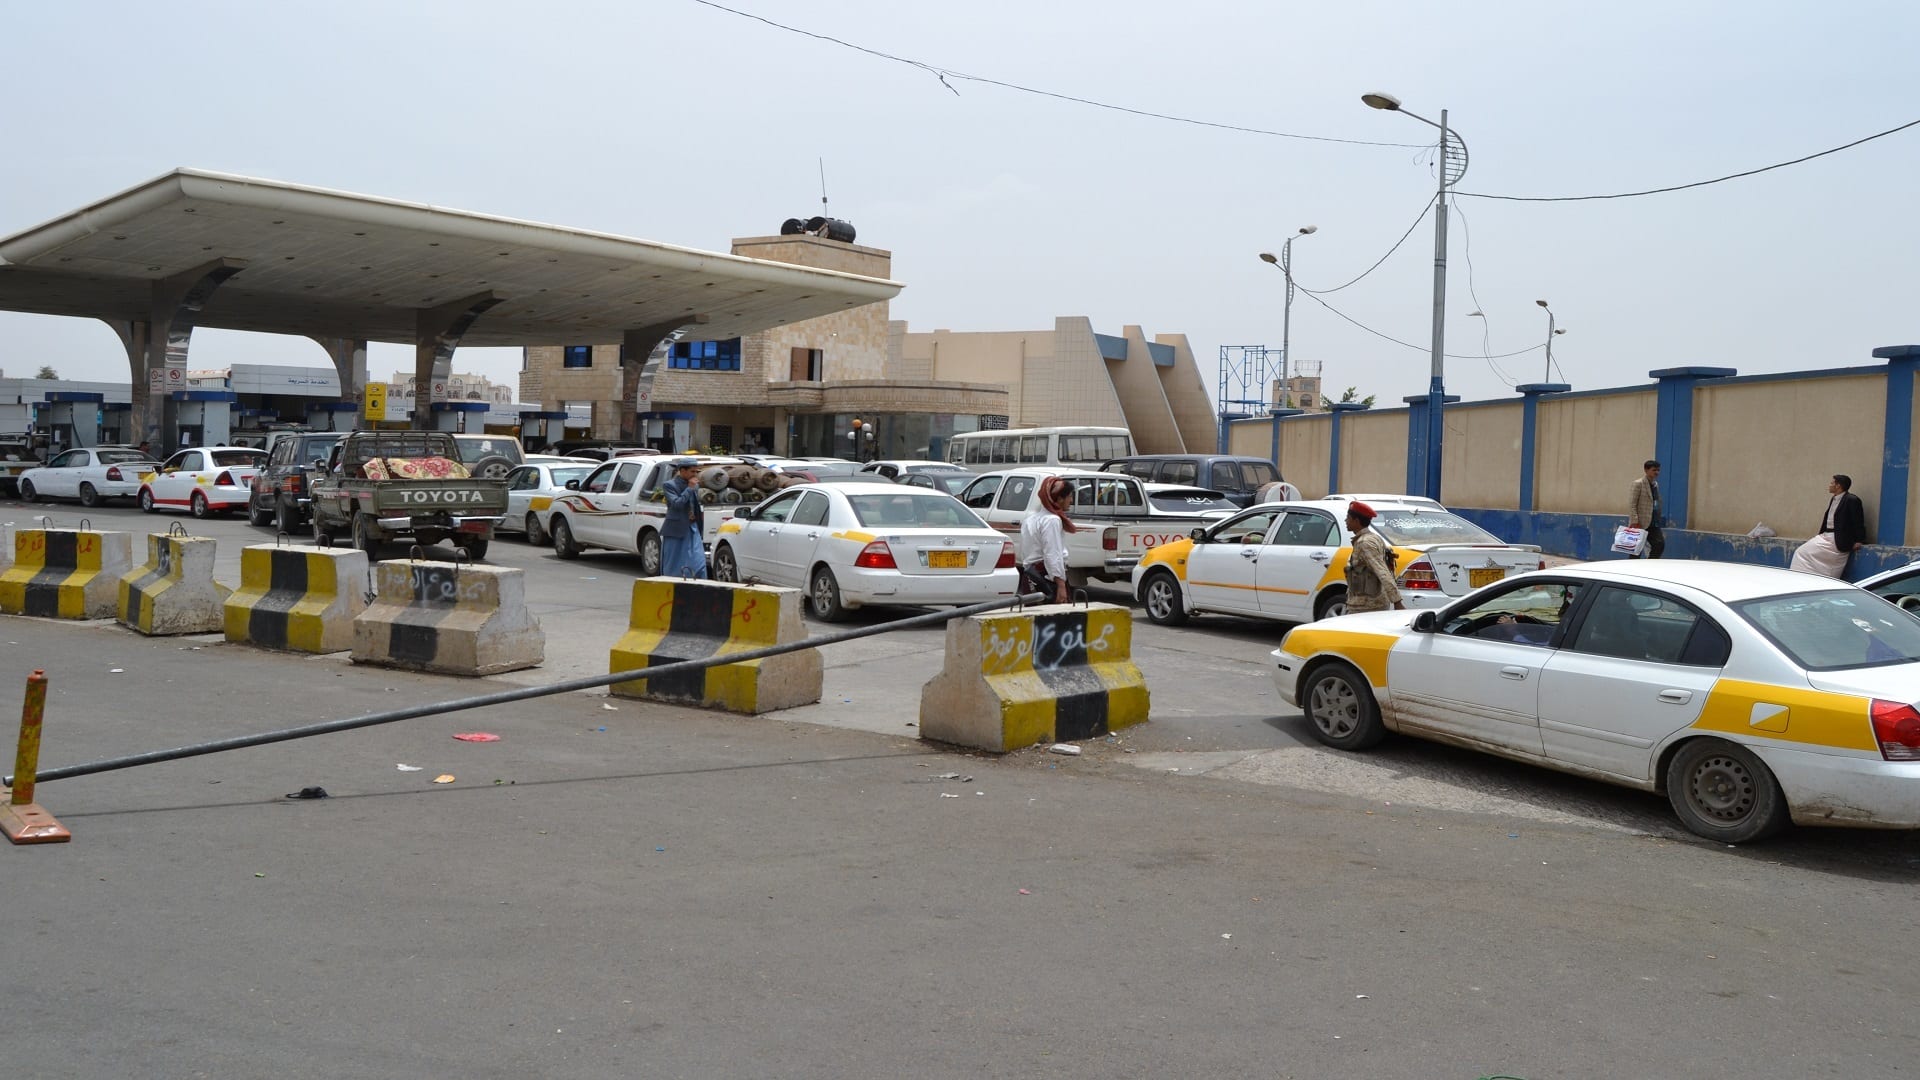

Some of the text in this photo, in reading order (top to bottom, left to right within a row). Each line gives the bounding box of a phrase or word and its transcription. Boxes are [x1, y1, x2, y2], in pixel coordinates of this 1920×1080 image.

[400, 490, 484, 503] TOYOTA
[1130, 534, 1189, 547] TOYO
[982, 624, 1115, 673] ممنوع الوقوف
